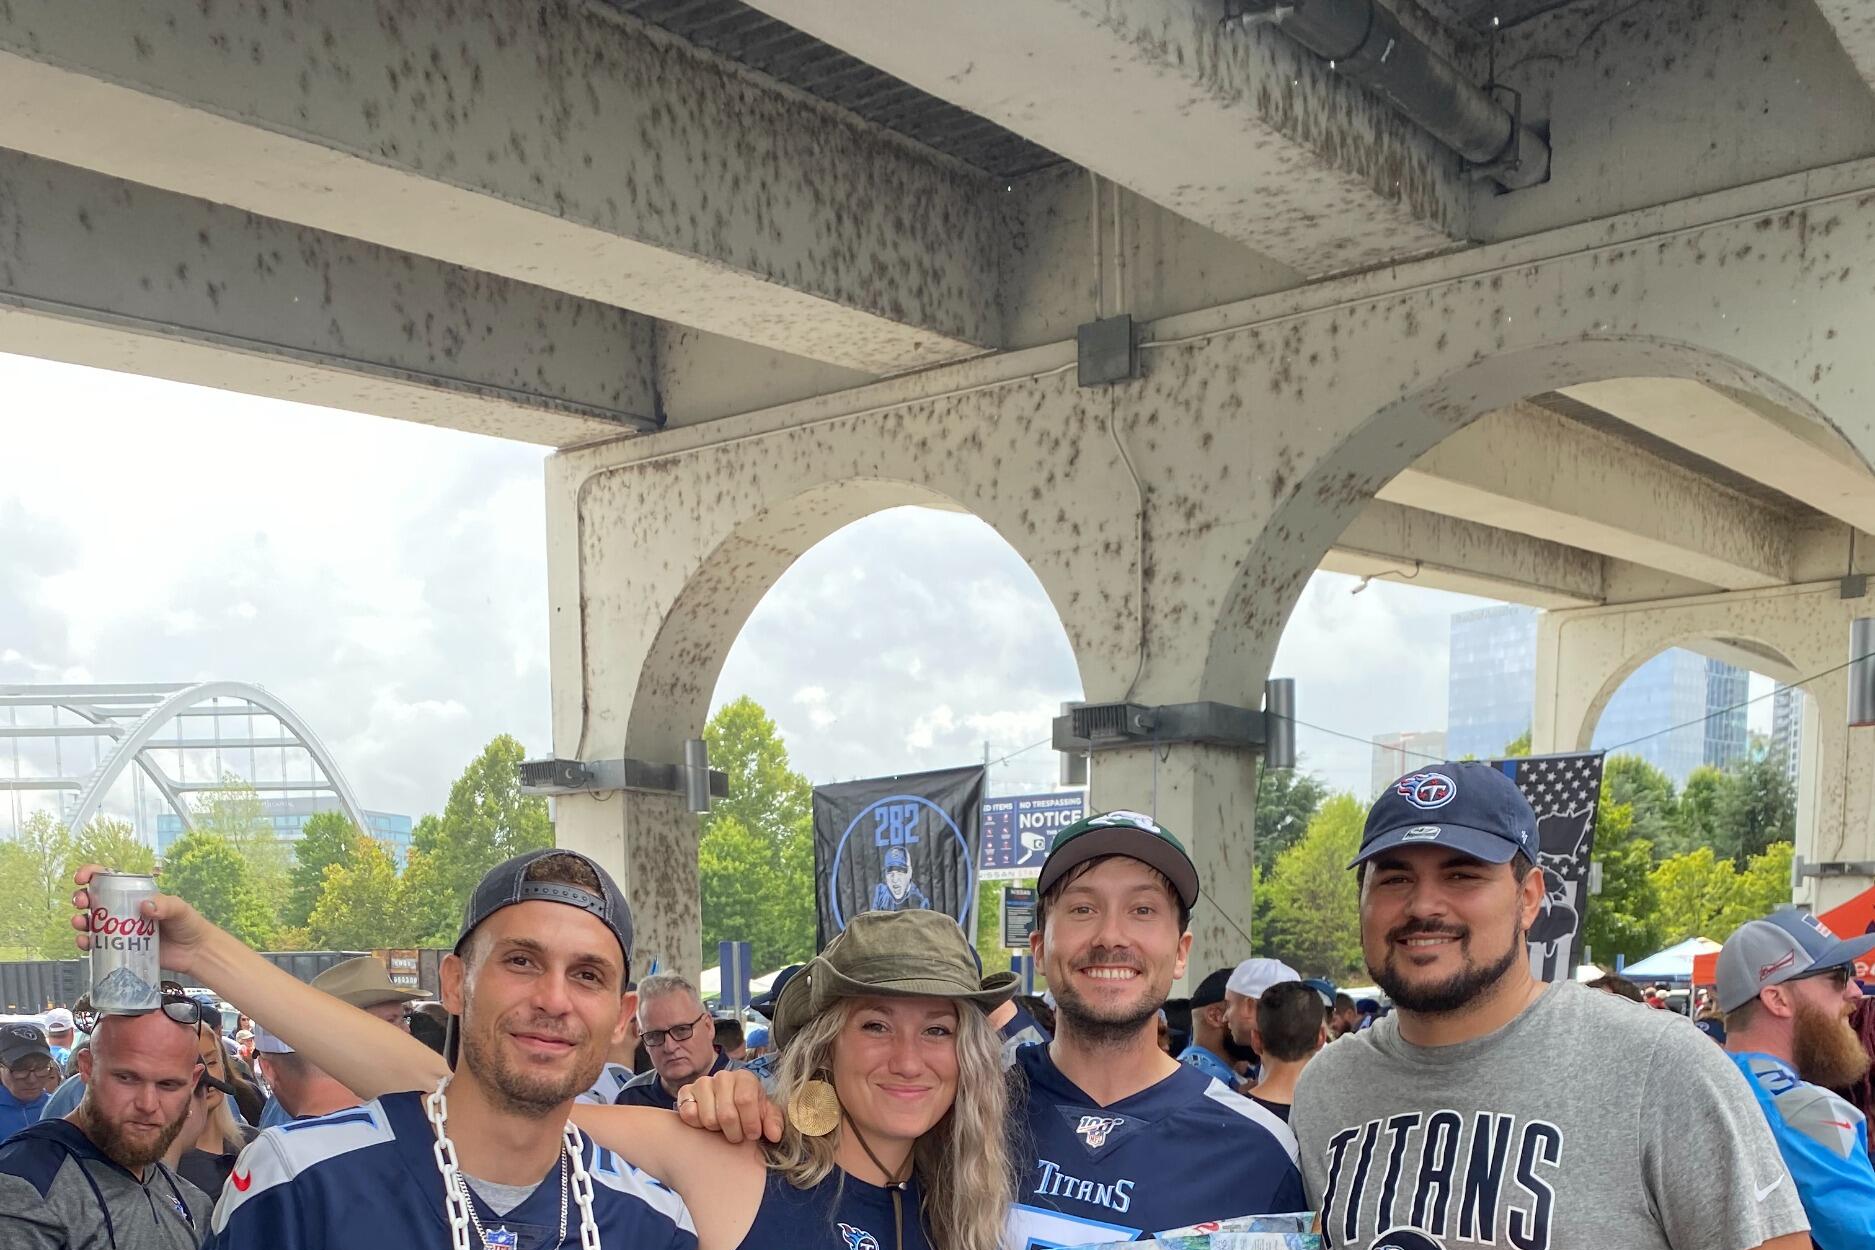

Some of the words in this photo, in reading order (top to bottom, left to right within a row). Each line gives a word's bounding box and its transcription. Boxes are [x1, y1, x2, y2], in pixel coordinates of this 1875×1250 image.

[993, 803, 1013, 811] ITEMS
[1032, 798, 1082, 808] TRESPASSING
[874, 802, 920, 847] 282
[1019, 809, 1082, 828] NOTICE
[91, 907, 155, 936] Coors
[95, 935, 151, 951] LIGHT
[1034, 1159, 1135, 1213] TITANS
